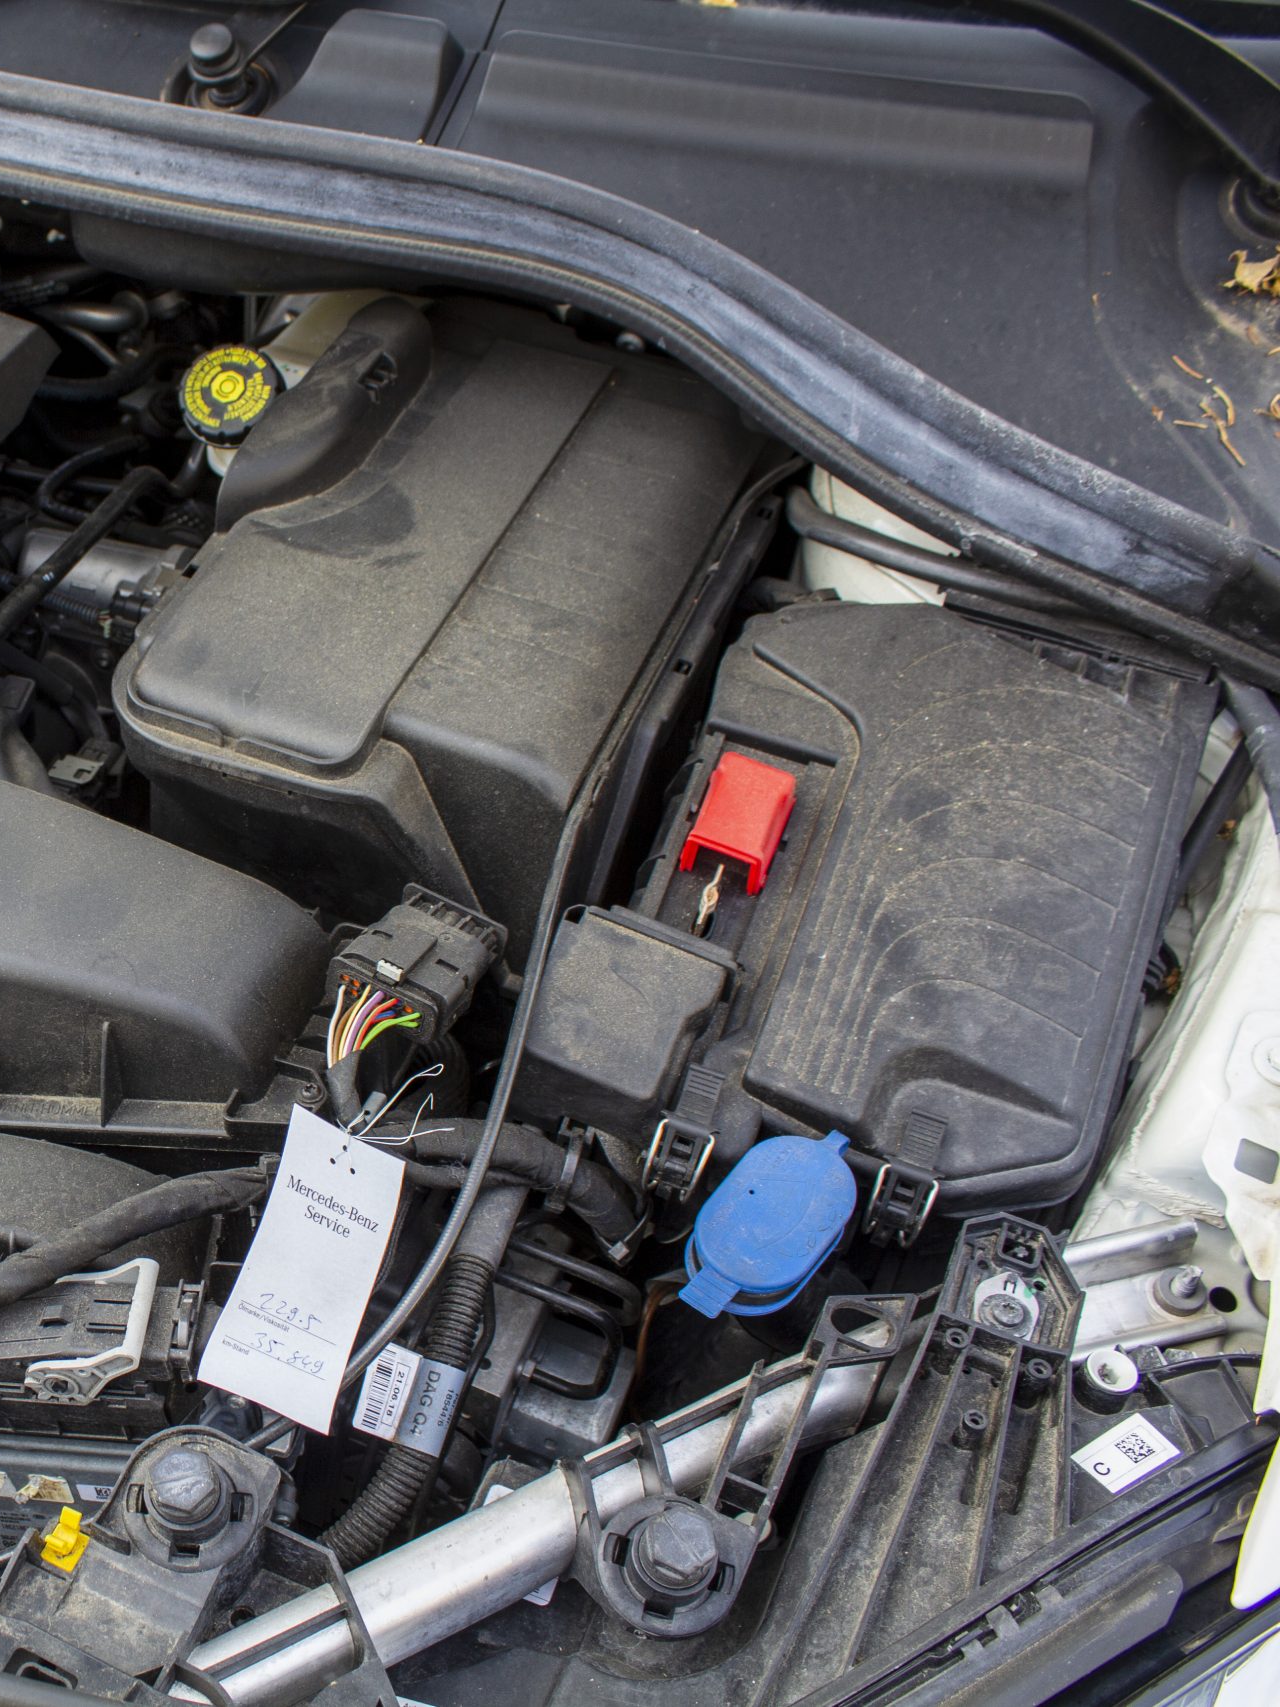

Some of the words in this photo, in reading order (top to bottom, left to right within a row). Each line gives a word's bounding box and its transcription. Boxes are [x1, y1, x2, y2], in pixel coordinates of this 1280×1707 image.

[286, 1174, 379, 1233] Mercedes-Benz
[303, 1206, 351, 1238] Service
[260, 1293, 322, 1330] 229.5
[222, 1339, 251, 1356] km-Stand
[385, 1371, 406, 1417] 21.06.18
[419, 1370, 441, 1408] DAG
[1093, 1462, 1111, 1476] C
